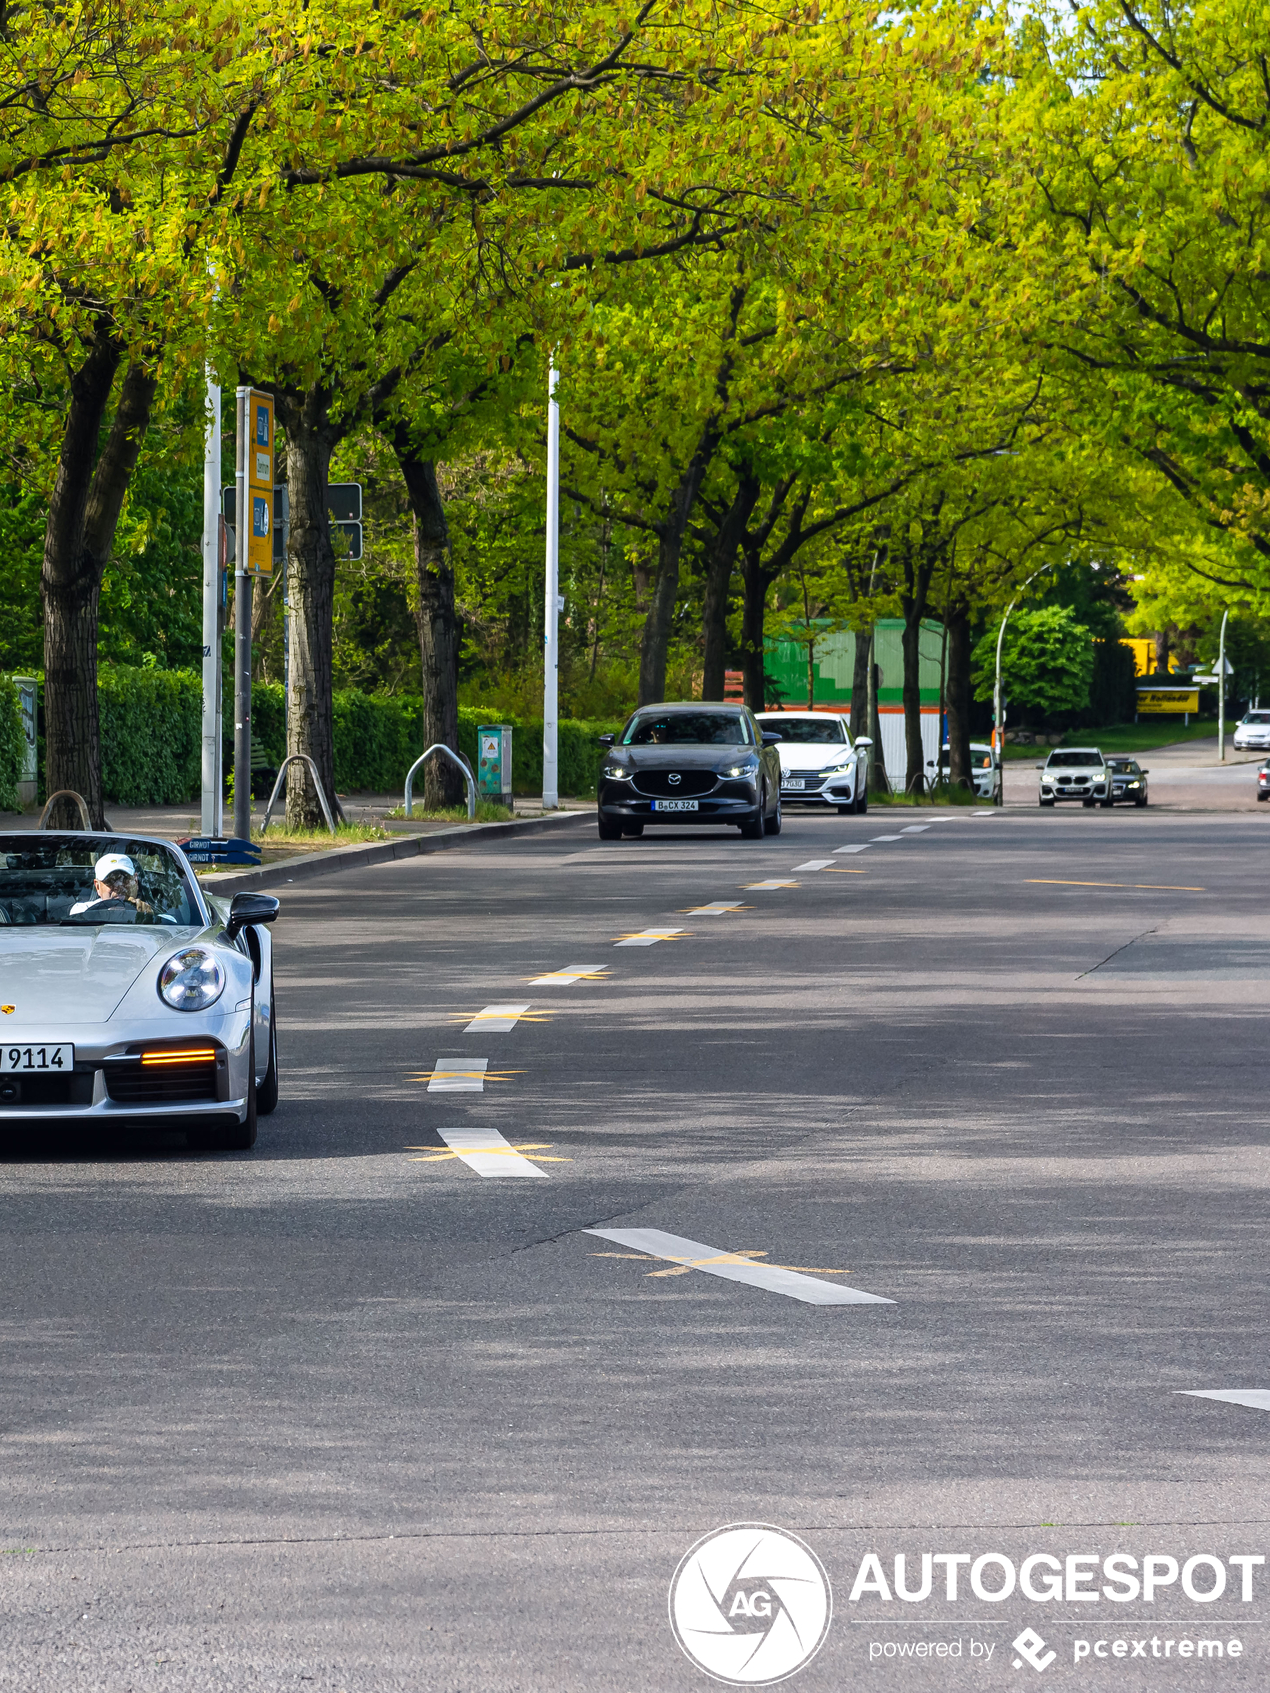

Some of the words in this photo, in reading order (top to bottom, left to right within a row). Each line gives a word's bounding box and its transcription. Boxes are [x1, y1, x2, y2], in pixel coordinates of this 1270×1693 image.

[658, 801, 664, 809] B
[668, 801, 679, 809] CX
[680, 801, 696, 809] 324
[8, 1047, 64, 1069] 9114
